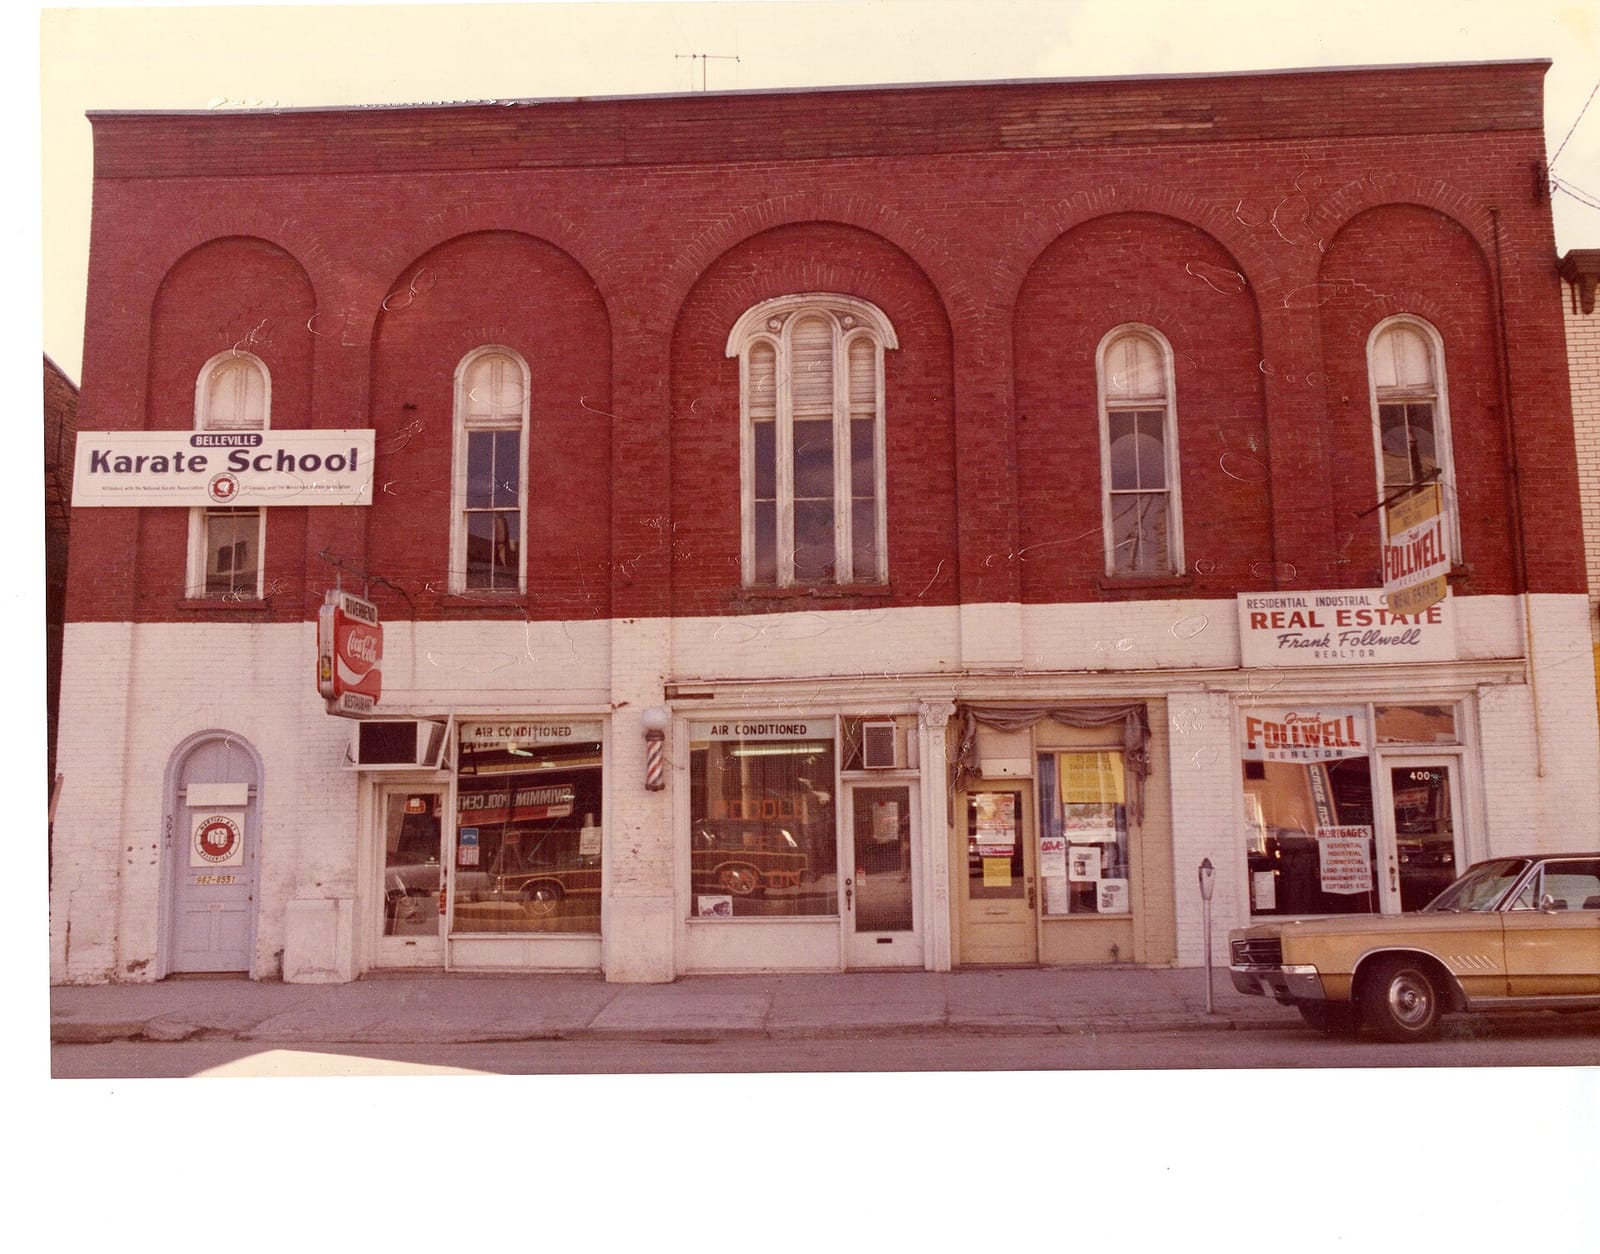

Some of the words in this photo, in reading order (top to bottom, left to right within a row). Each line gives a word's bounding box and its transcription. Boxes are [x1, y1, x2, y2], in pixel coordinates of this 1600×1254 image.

[195, 435, 257, 446] BELLEVILLE
[90, 449, 208, 473] Karate
[227, 447, 358, 473] School
[1383, 519, 1446, 584] FOLLWELL
[1247, 596, 1308, 609] RESIDENTIAL
[1315, 595, 1371, 607] INDUSTRIAL
[345, 598, 376, 623] RIVERBEND
[1250, 610, 1325, 629] REAL
[1336, 607, 1442, 627] ESTATE
[1277, 632, 1330, 649] Frank
[1338, 629, 1422, 647] Follwell
[1314, 650, 1375, 659] REALTOR
[1285, 712, 1321, 725] Frank
[475, 727, 493, 737] AIR
[498, 726, 572, 737] CONDITIONED
[710, 725, 729, 735] AIR
[735, 724, 807, 735] CONDITIONED
[1246, 715, 1361, 750] FOLLWELL
[1269, 750, 1343, 759] REALTOR
[1410, 771, 1430, 781] 400
[1318, 828, 1368, 839] MORTGAGES
